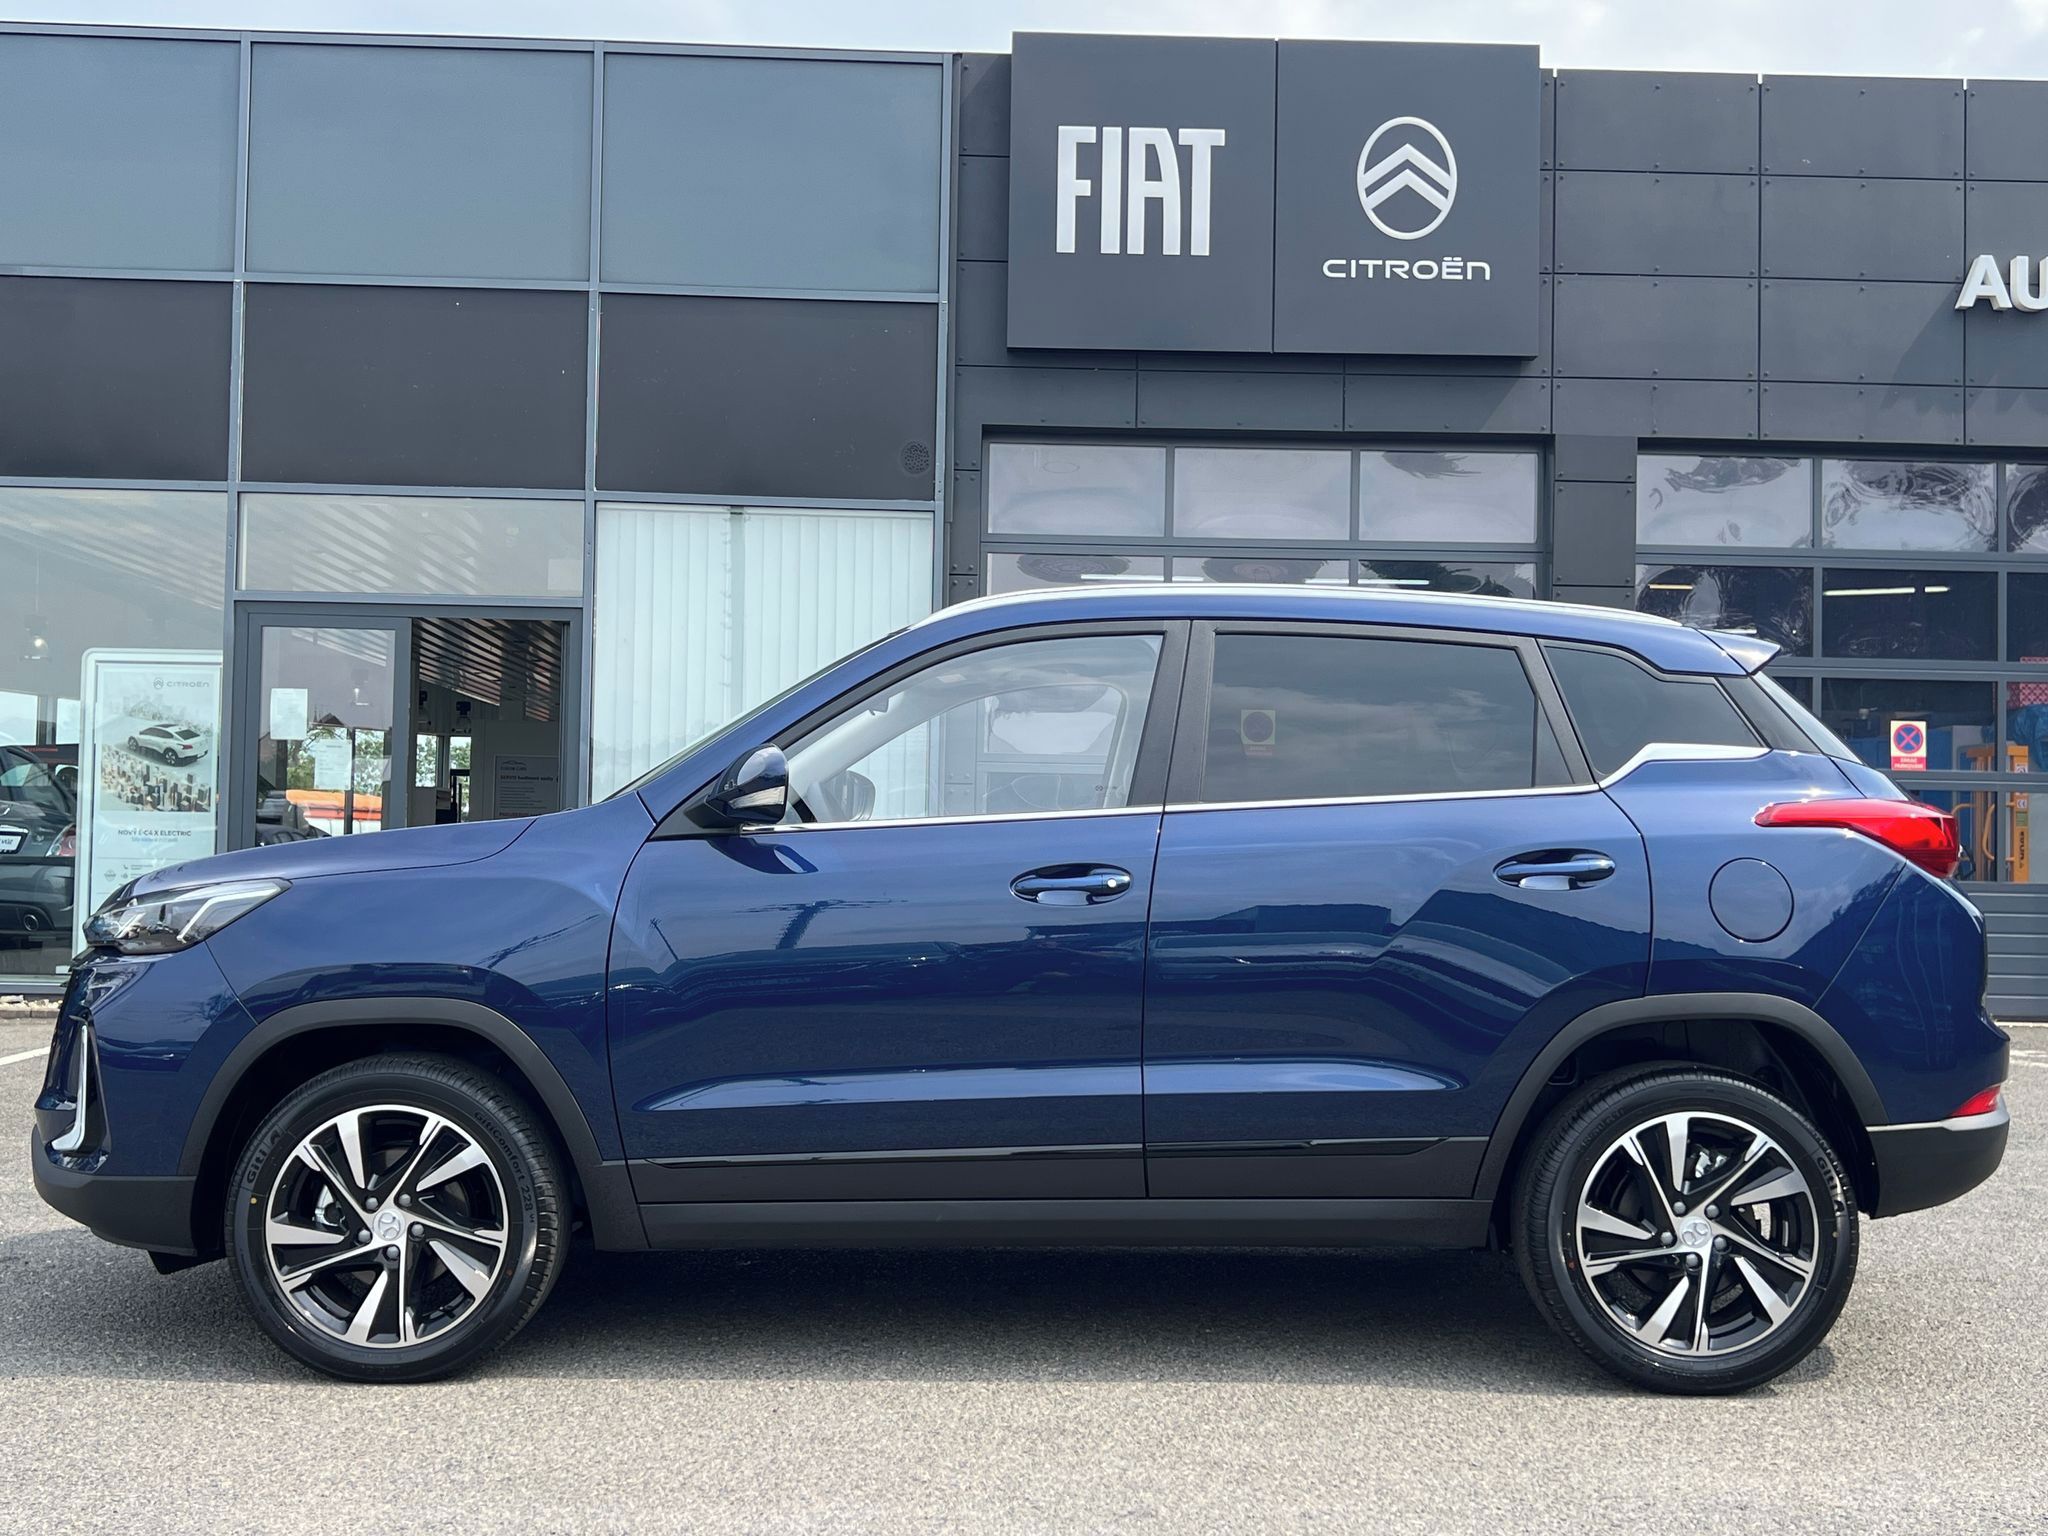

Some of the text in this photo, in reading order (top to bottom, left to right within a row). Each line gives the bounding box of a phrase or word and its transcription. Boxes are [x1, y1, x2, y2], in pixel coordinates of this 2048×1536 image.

[1056, 126, 1226, 256] FIAT
[1322, 256, 1491, 280] CITROËN
[1954, 254, 2048, 313] AU
[521, 1185, 534, 1212] 228
